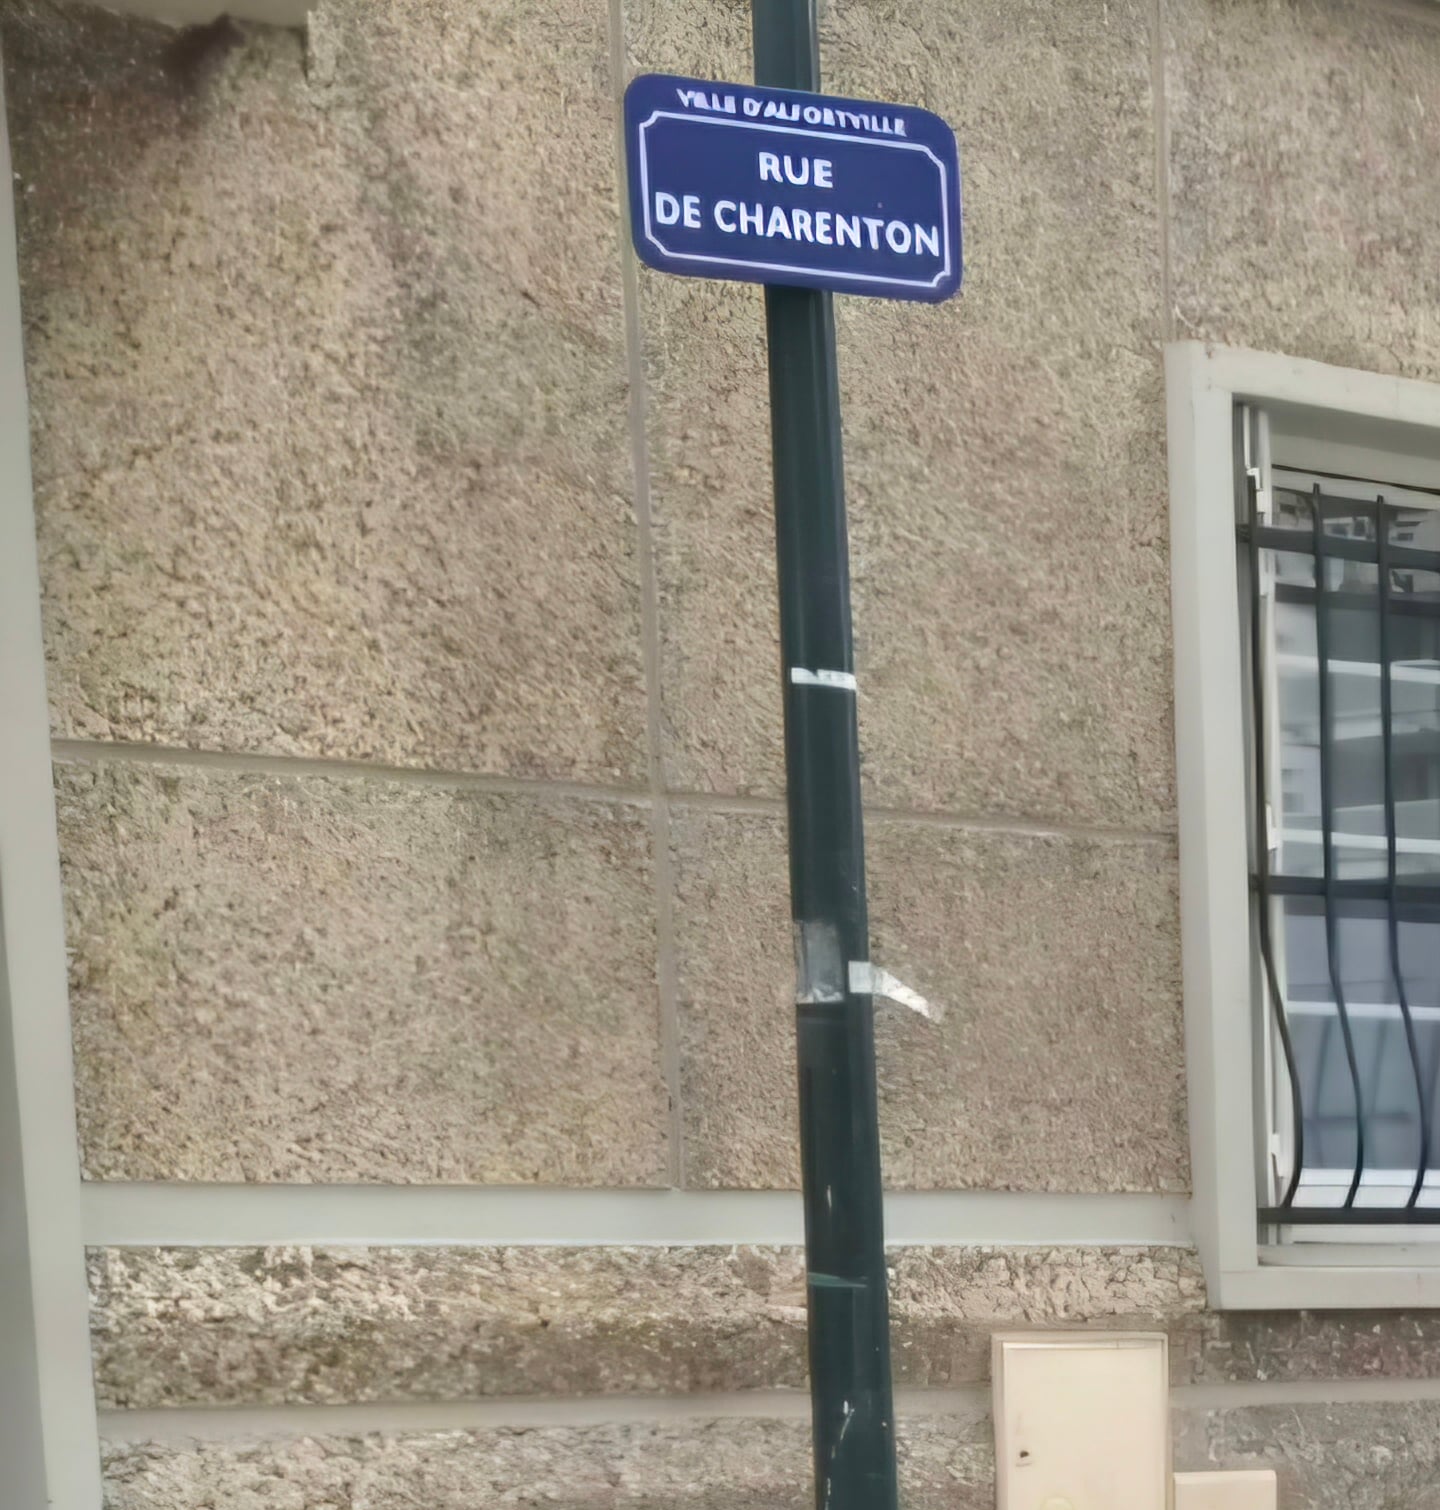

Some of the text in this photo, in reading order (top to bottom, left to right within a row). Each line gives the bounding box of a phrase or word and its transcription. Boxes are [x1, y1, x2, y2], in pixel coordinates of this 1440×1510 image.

[759, 151, 834, 189] RUE
[655, 191, 940, 257] DE CHARENTON
